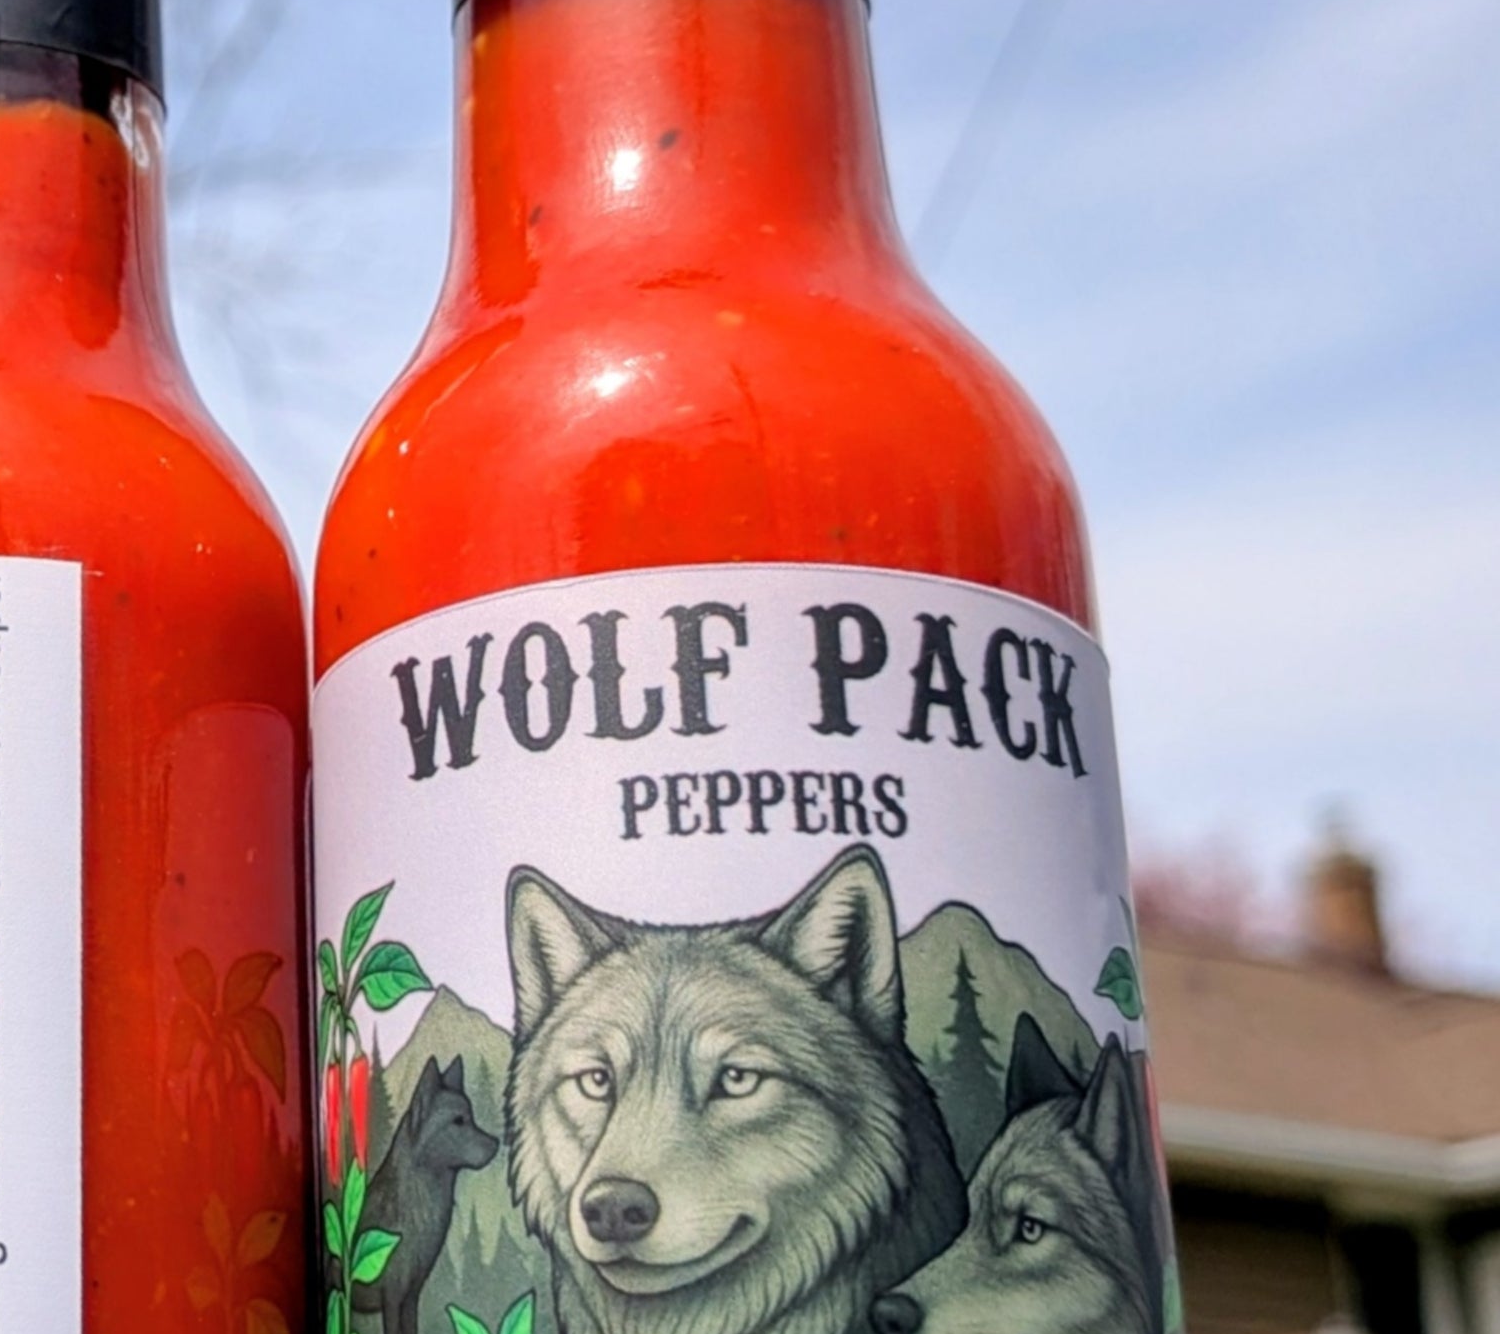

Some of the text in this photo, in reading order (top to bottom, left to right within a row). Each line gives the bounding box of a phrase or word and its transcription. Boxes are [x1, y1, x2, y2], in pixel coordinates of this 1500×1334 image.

[390, 601, 1089, 782] WOLF PACK
[617, 769, 908, 842] PEPPERS
